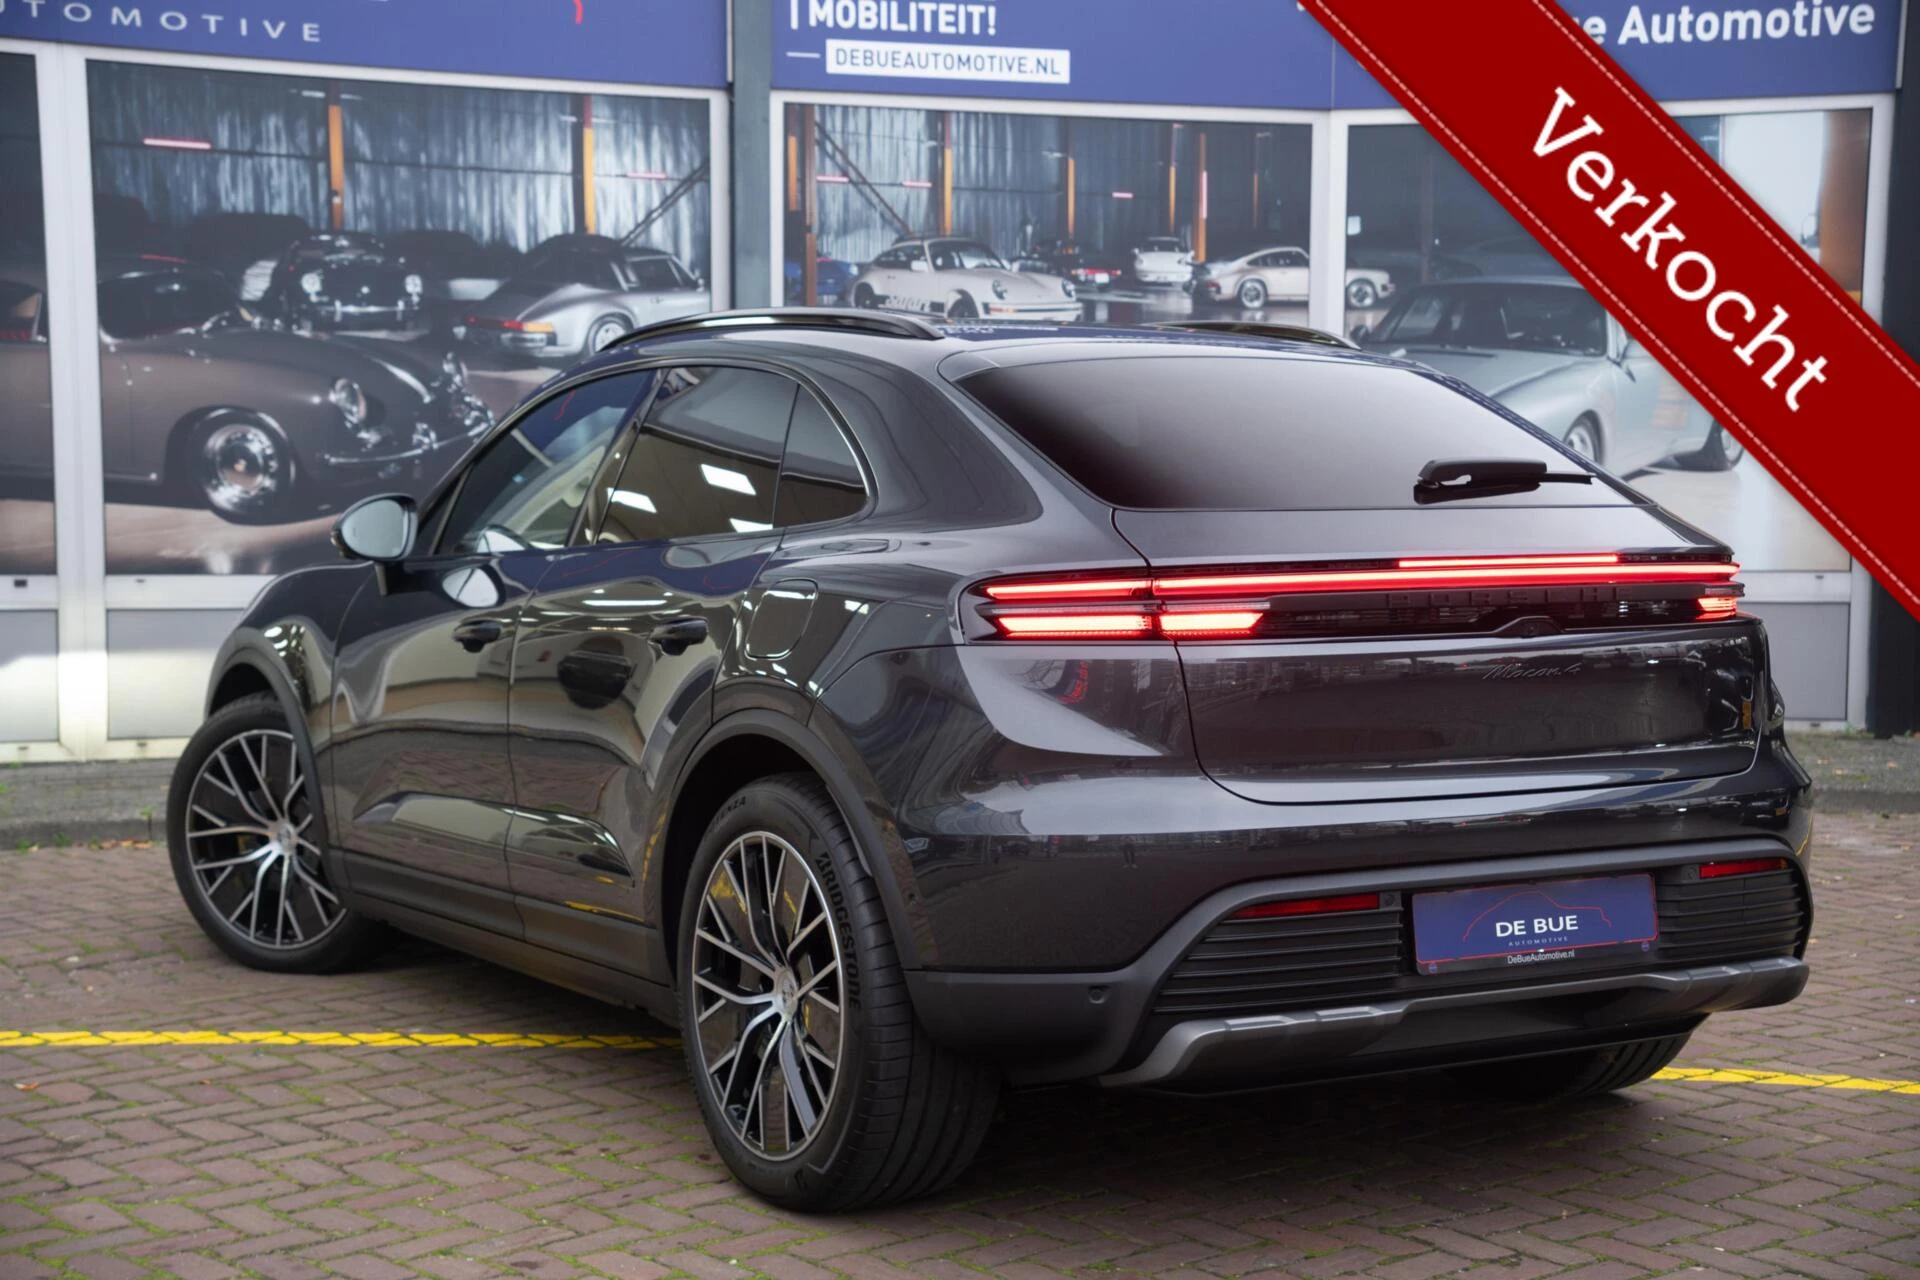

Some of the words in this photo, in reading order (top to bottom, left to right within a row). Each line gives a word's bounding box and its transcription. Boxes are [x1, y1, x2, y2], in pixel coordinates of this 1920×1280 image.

[0, 0, 321, 42] TOMOTIVE
[808, 0, 997, 36] MOBILITEIT!
[1571, 16, 1607, 45] e
[1617, 1, 1876, 45] Automotive
[835, 48, 1061, 75] DEBUEAUTOMOTIVE.NL
[816, 852, 862, 1011] BRIDGESTONE
[1495, 920, 1527, 938] DE
[1533, 915, 1579, 934] BUE
[1508, 936, 1568, 947] AUTOMOTIVE
[1507, 949, 1575, 965] DeBueAutomotive.nl
